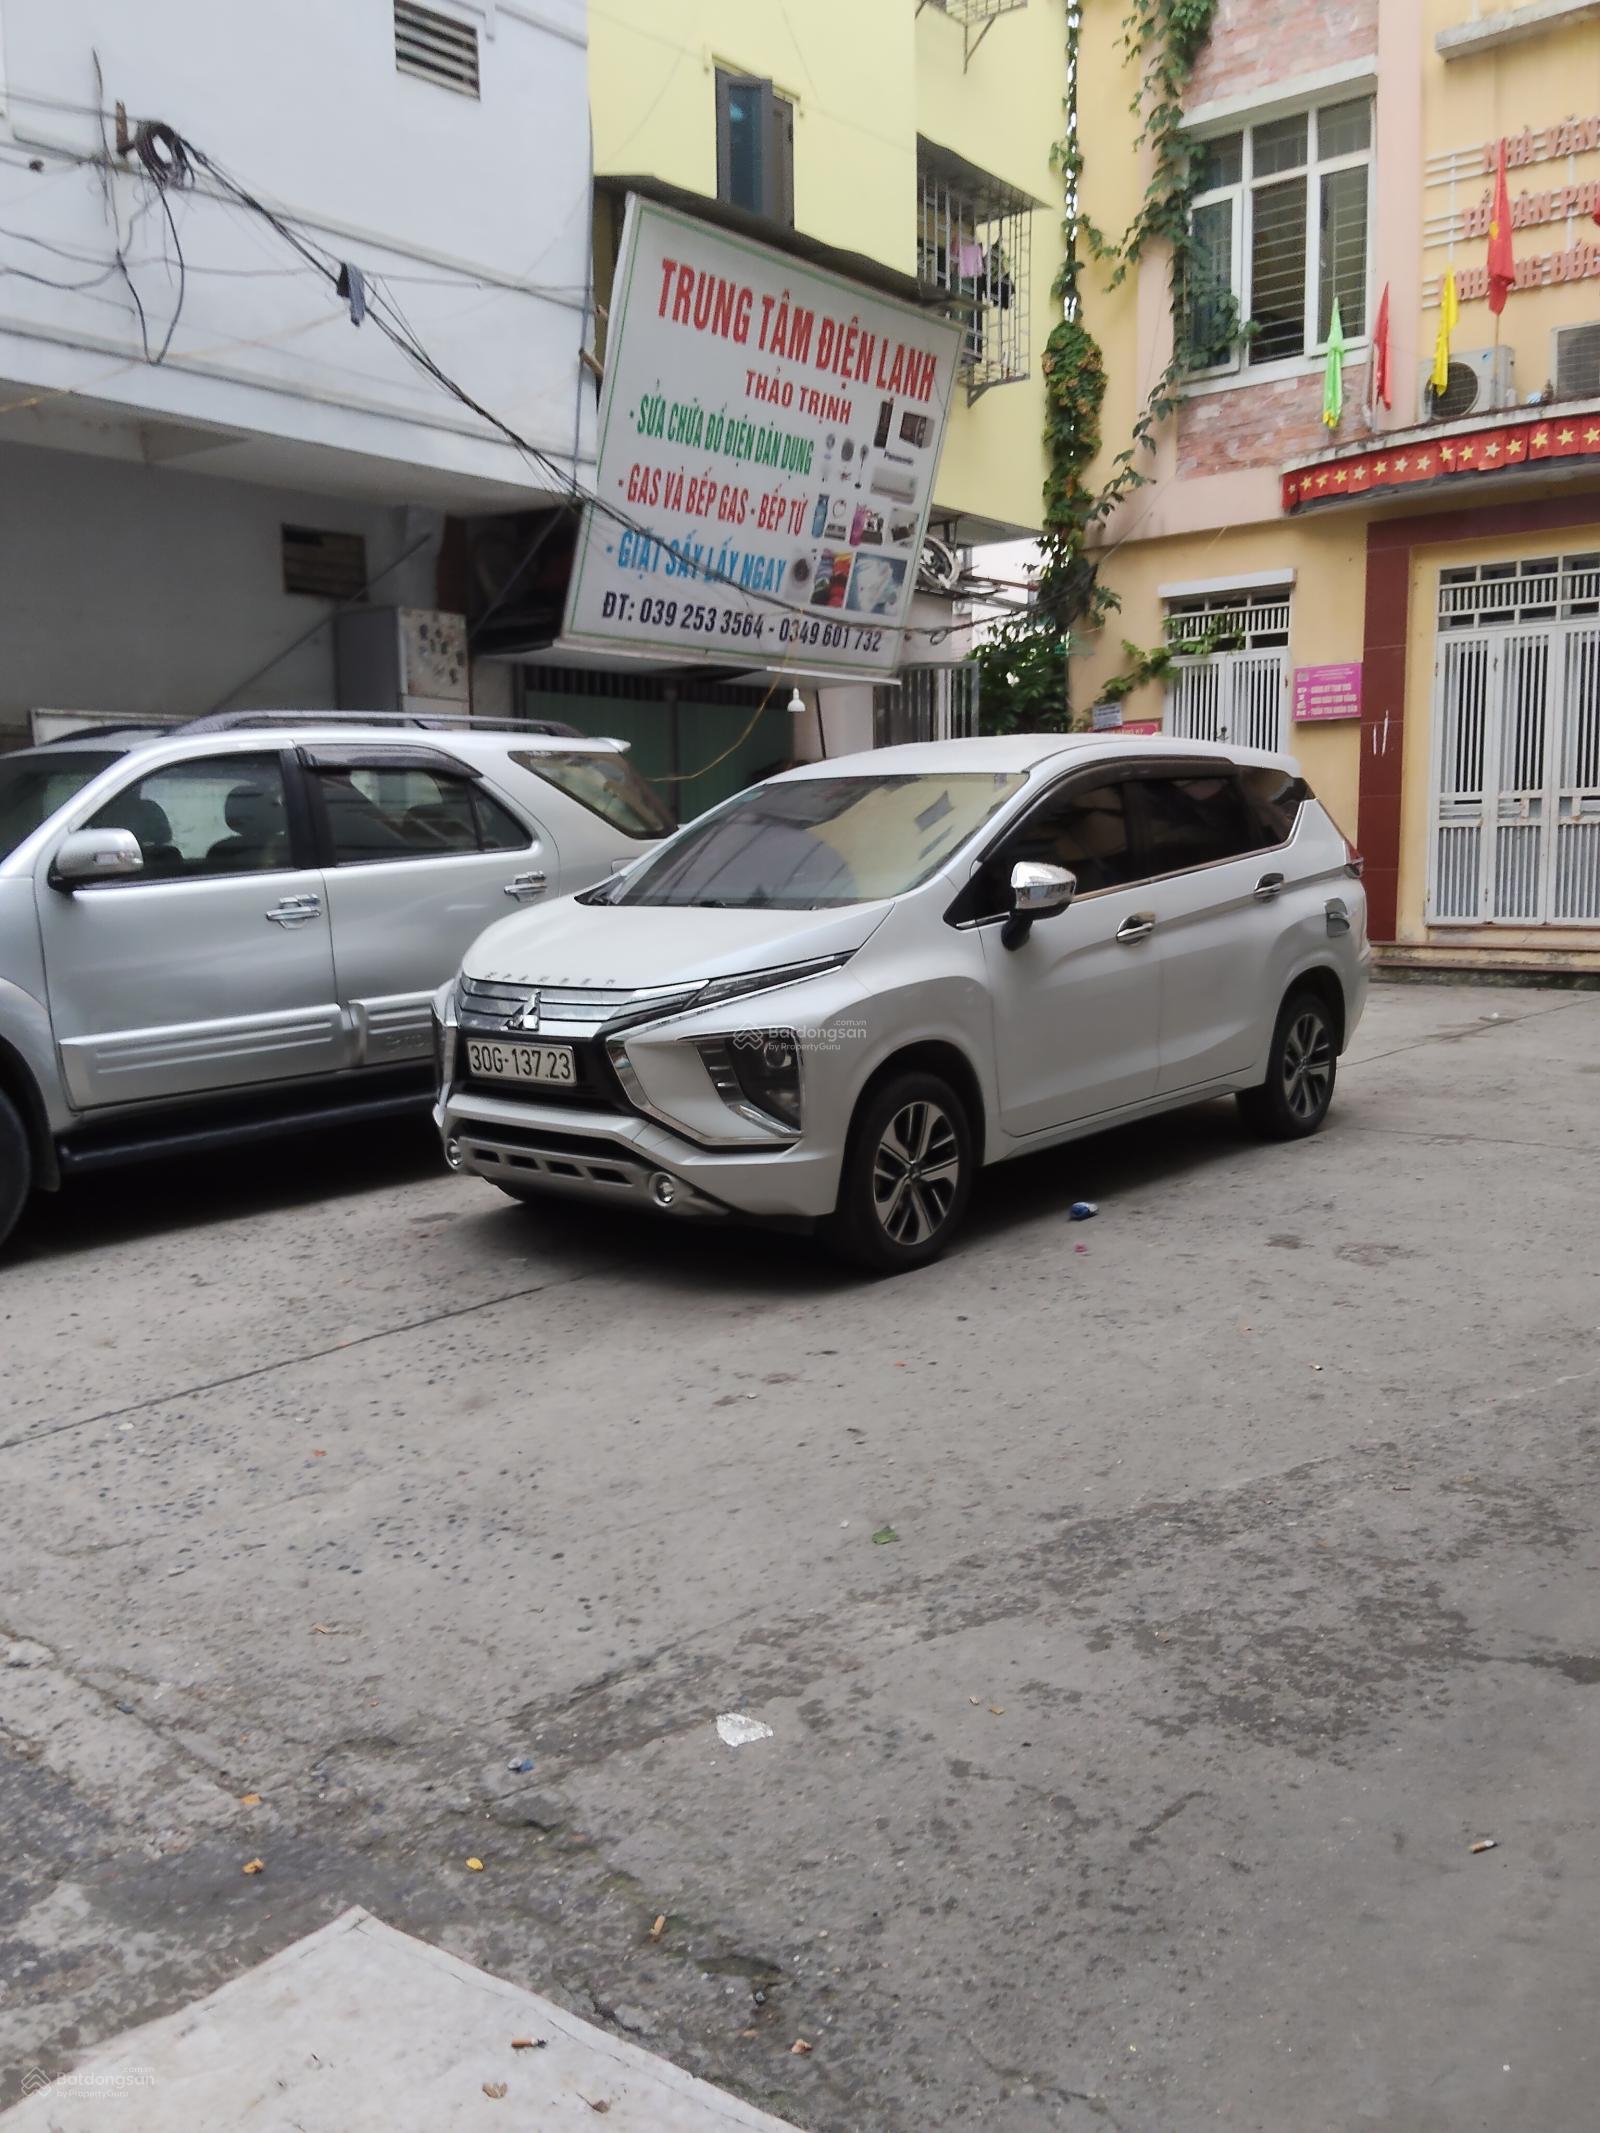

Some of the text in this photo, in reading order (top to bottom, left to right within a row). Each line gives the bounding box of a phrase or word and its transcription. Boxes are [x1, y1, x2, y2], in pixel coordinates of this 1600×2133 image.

[657, 257, 938, 403] TRUNG TÂM ĐIỆN LẠNH
[745, 365, 853, 425] THẢO TRỊNH
[637, 378, 667, 439] SỬA
[780, 433, 815, 480] DỤNG
[627, 463, 662, 507] GAS
[663, 465, 685, 512] VÀ
[685, 467, 717, 518] BẾP
[717, 483, 749, 525] GAS
[757, 483, 786, 532] BẾP
[739, 552, 787, 593] NGAY
[602, 590, 635, 622] ĐT:
[639, 597, 677, 628] 039
[681, 603, 717, 633] 253
[720, 609, 764, 639] 3564
[779, 618, 820, 645] 0349
[822, 623, 850, 648] 601
